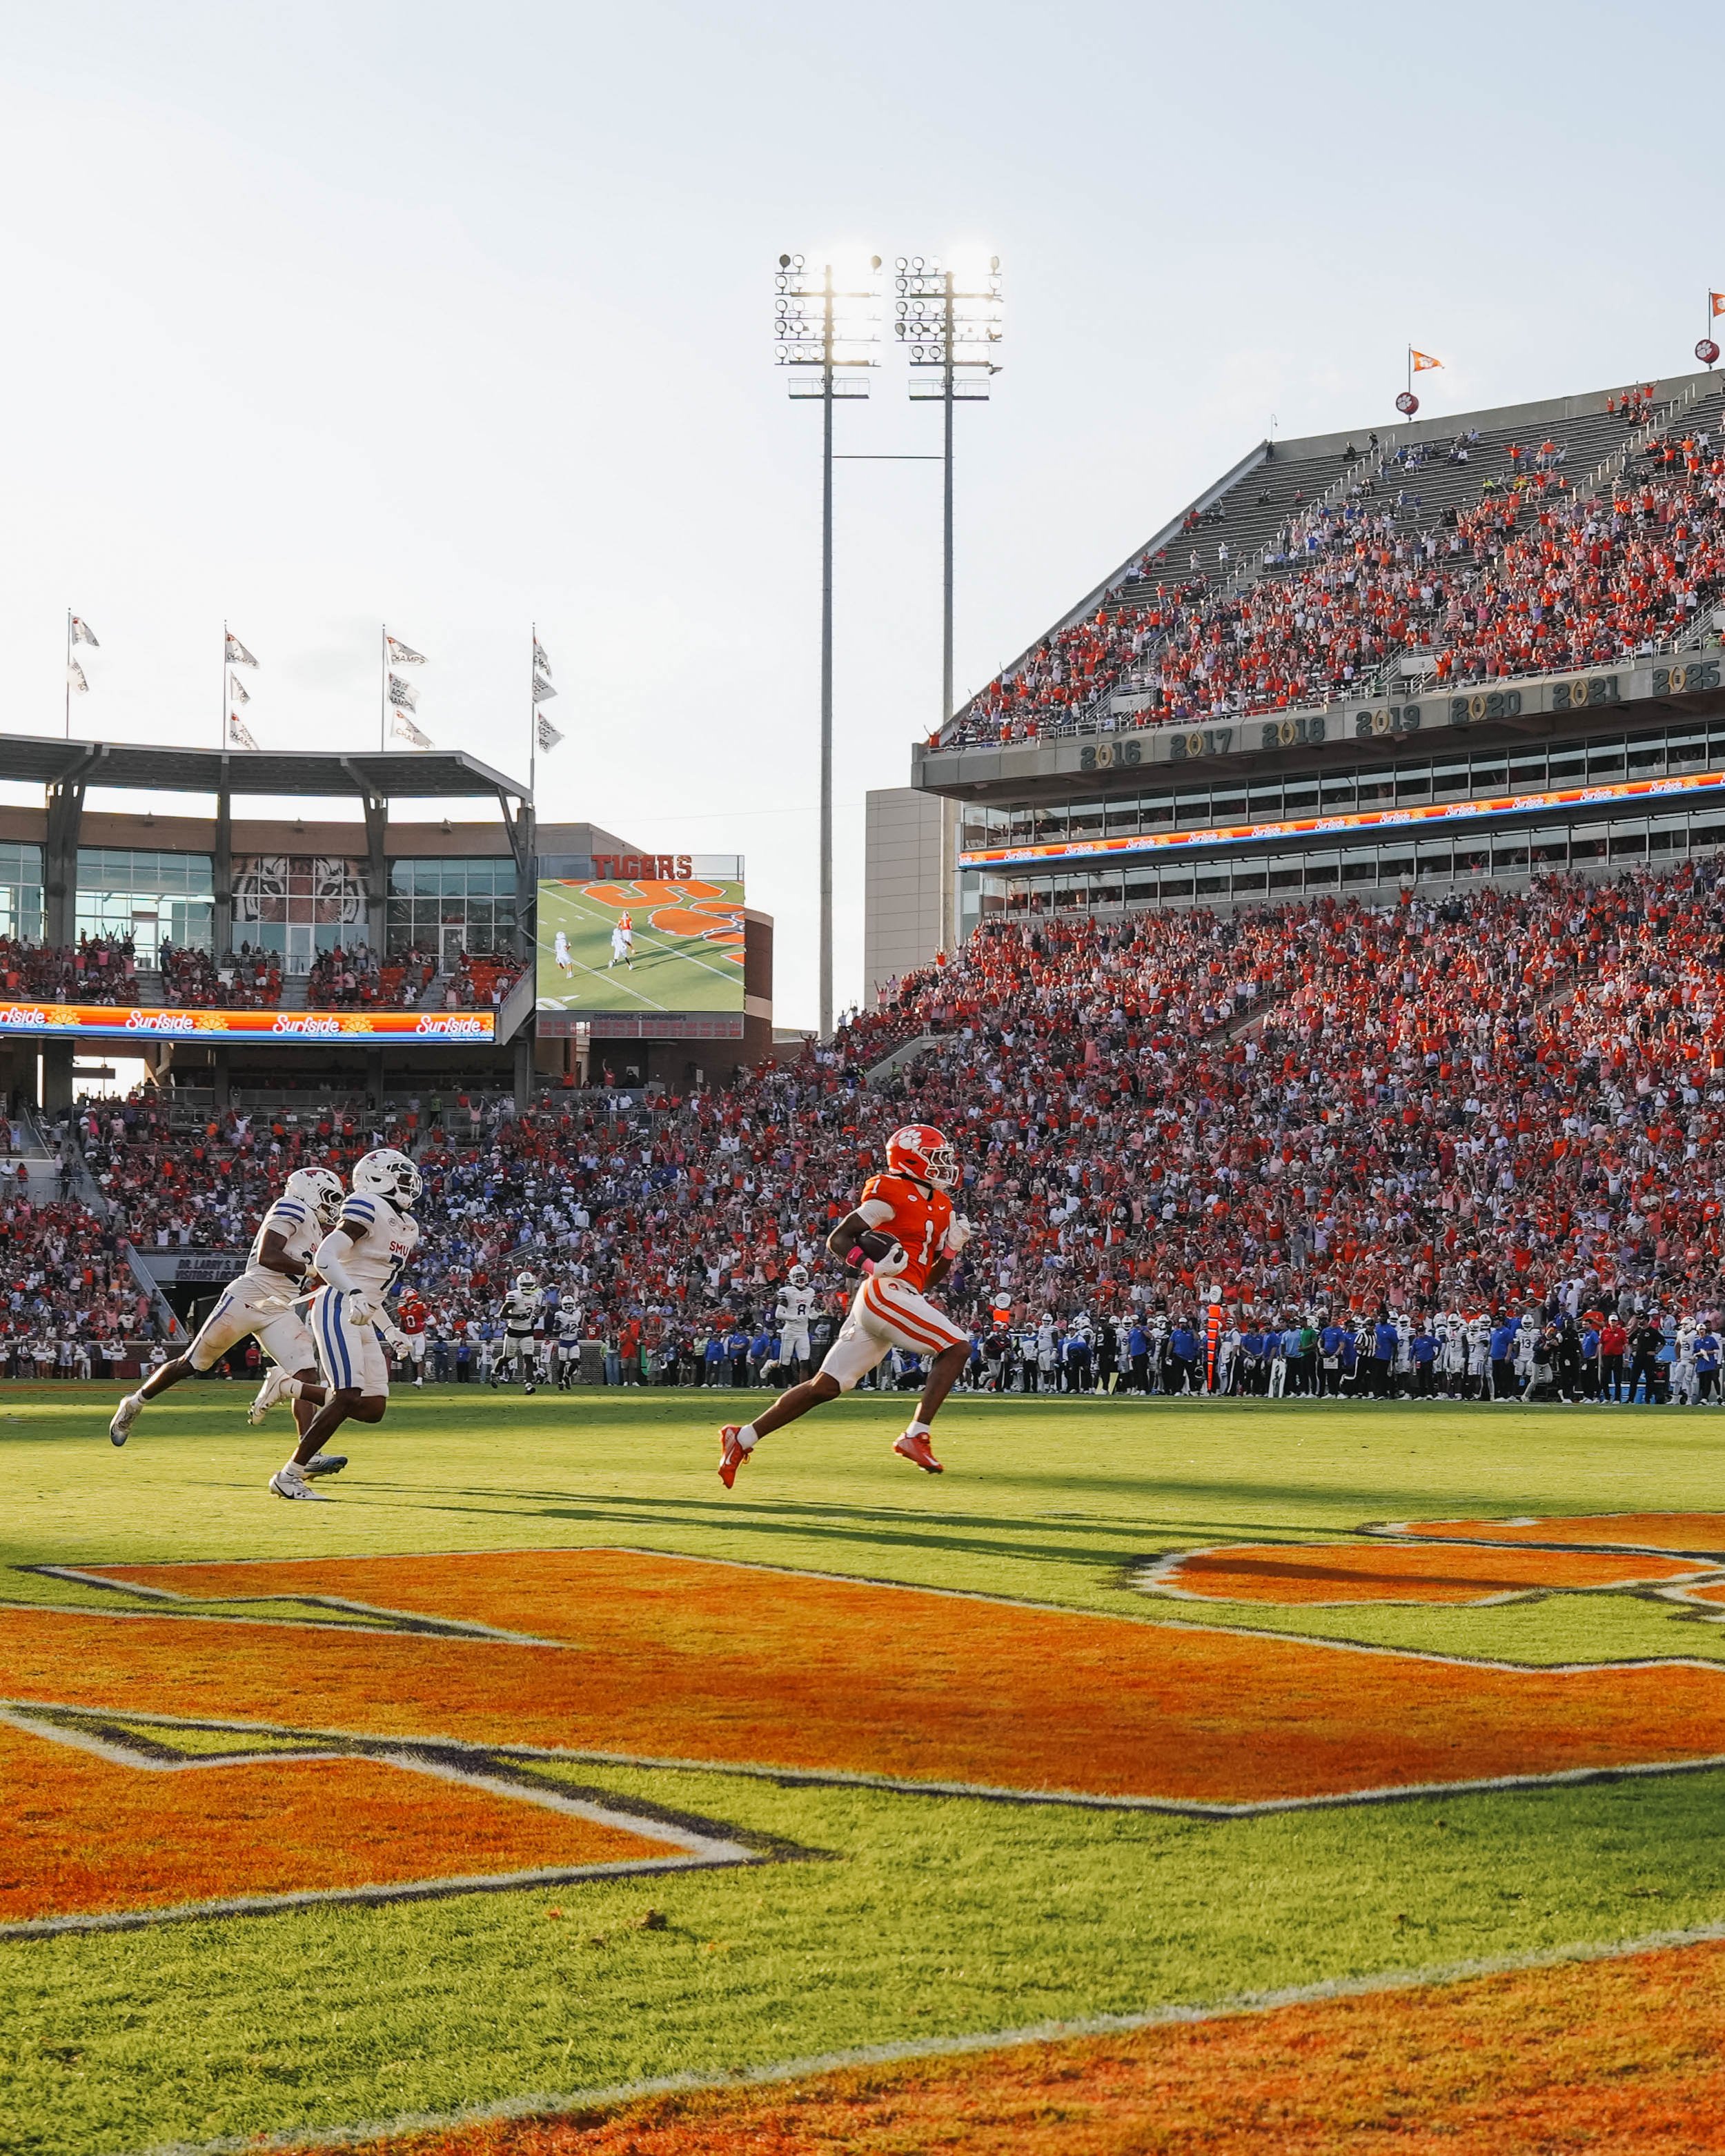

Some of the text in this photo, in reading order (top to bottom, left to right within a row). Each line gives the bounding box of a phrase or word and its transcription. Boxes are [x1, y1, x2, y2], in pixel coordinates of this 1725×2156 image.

[1653, 660, 1720, 695] 2025
[1451, 690, 1522, 724] 2020
[1553, 675, 1621, 710] 2021
[1262, 718, 1325, 748] 2018
[1356, 704, 1420, 736] 2019
[1081, 740, 1141, 769] 2016
[1170, 729, 1232, 759] 2017
[592, 855, 692, 880] TIGERS
[125, 1009, 194, 1031] Surfside
[273, 1014, 339, 1034] Surfside
[416, 1015, 481, 1034] Surfside
[389, 1240, 408, 1256] SMU
[379, 1254, 403, 1292] 7
[406, 1315, 415, 1328] 0
[1521, 1338, 1531, 1349] 13
